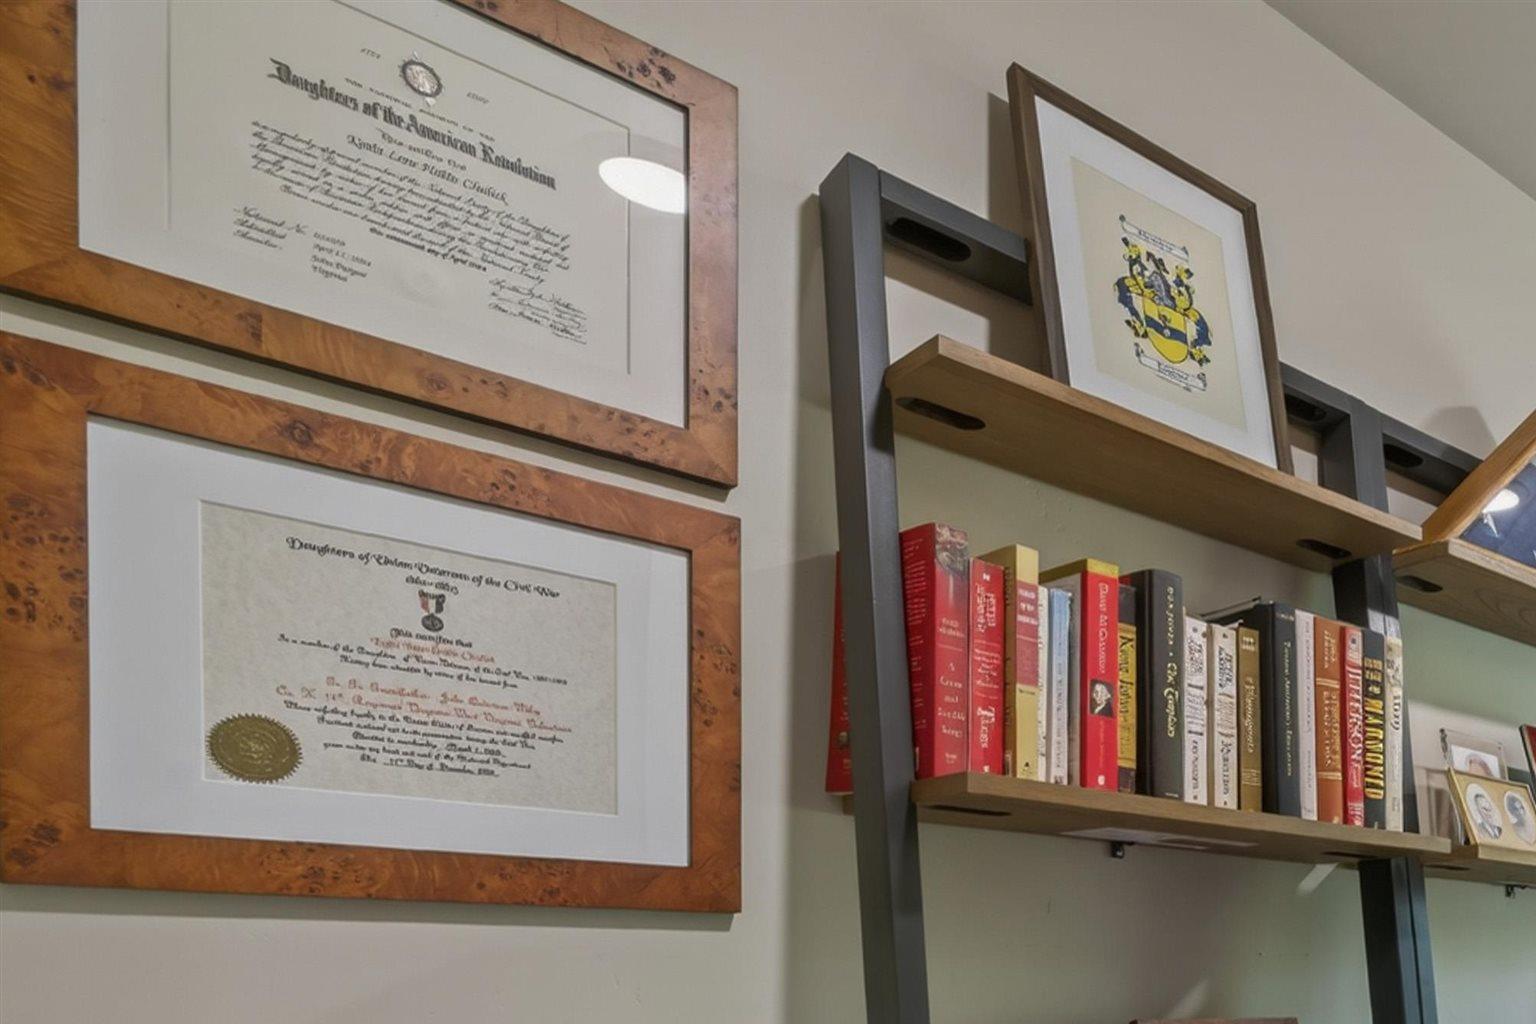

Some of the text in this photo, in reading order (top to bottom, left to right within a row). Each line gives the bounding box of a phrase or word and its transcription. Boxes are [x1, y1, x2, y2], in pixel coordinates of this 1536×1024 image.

[267, 57, 359, 112] Daughters
[362, 101, 381, 120] of
[381, 105, 405, 130] the
[405, 113, 477, 158] American
[479, 141, 557, 191] Revolution
[286, 536, 355, 557] Daughters
[358, 552, 371, 565] of
[472, 574, 483, 587] of
[503, 578, 531, 593] Civil
[1165, 609, 1175, 645] JONES
[1163, 684, 1179, 738] Templars
[1346, 666, 1364, 765] JEFFERSON
